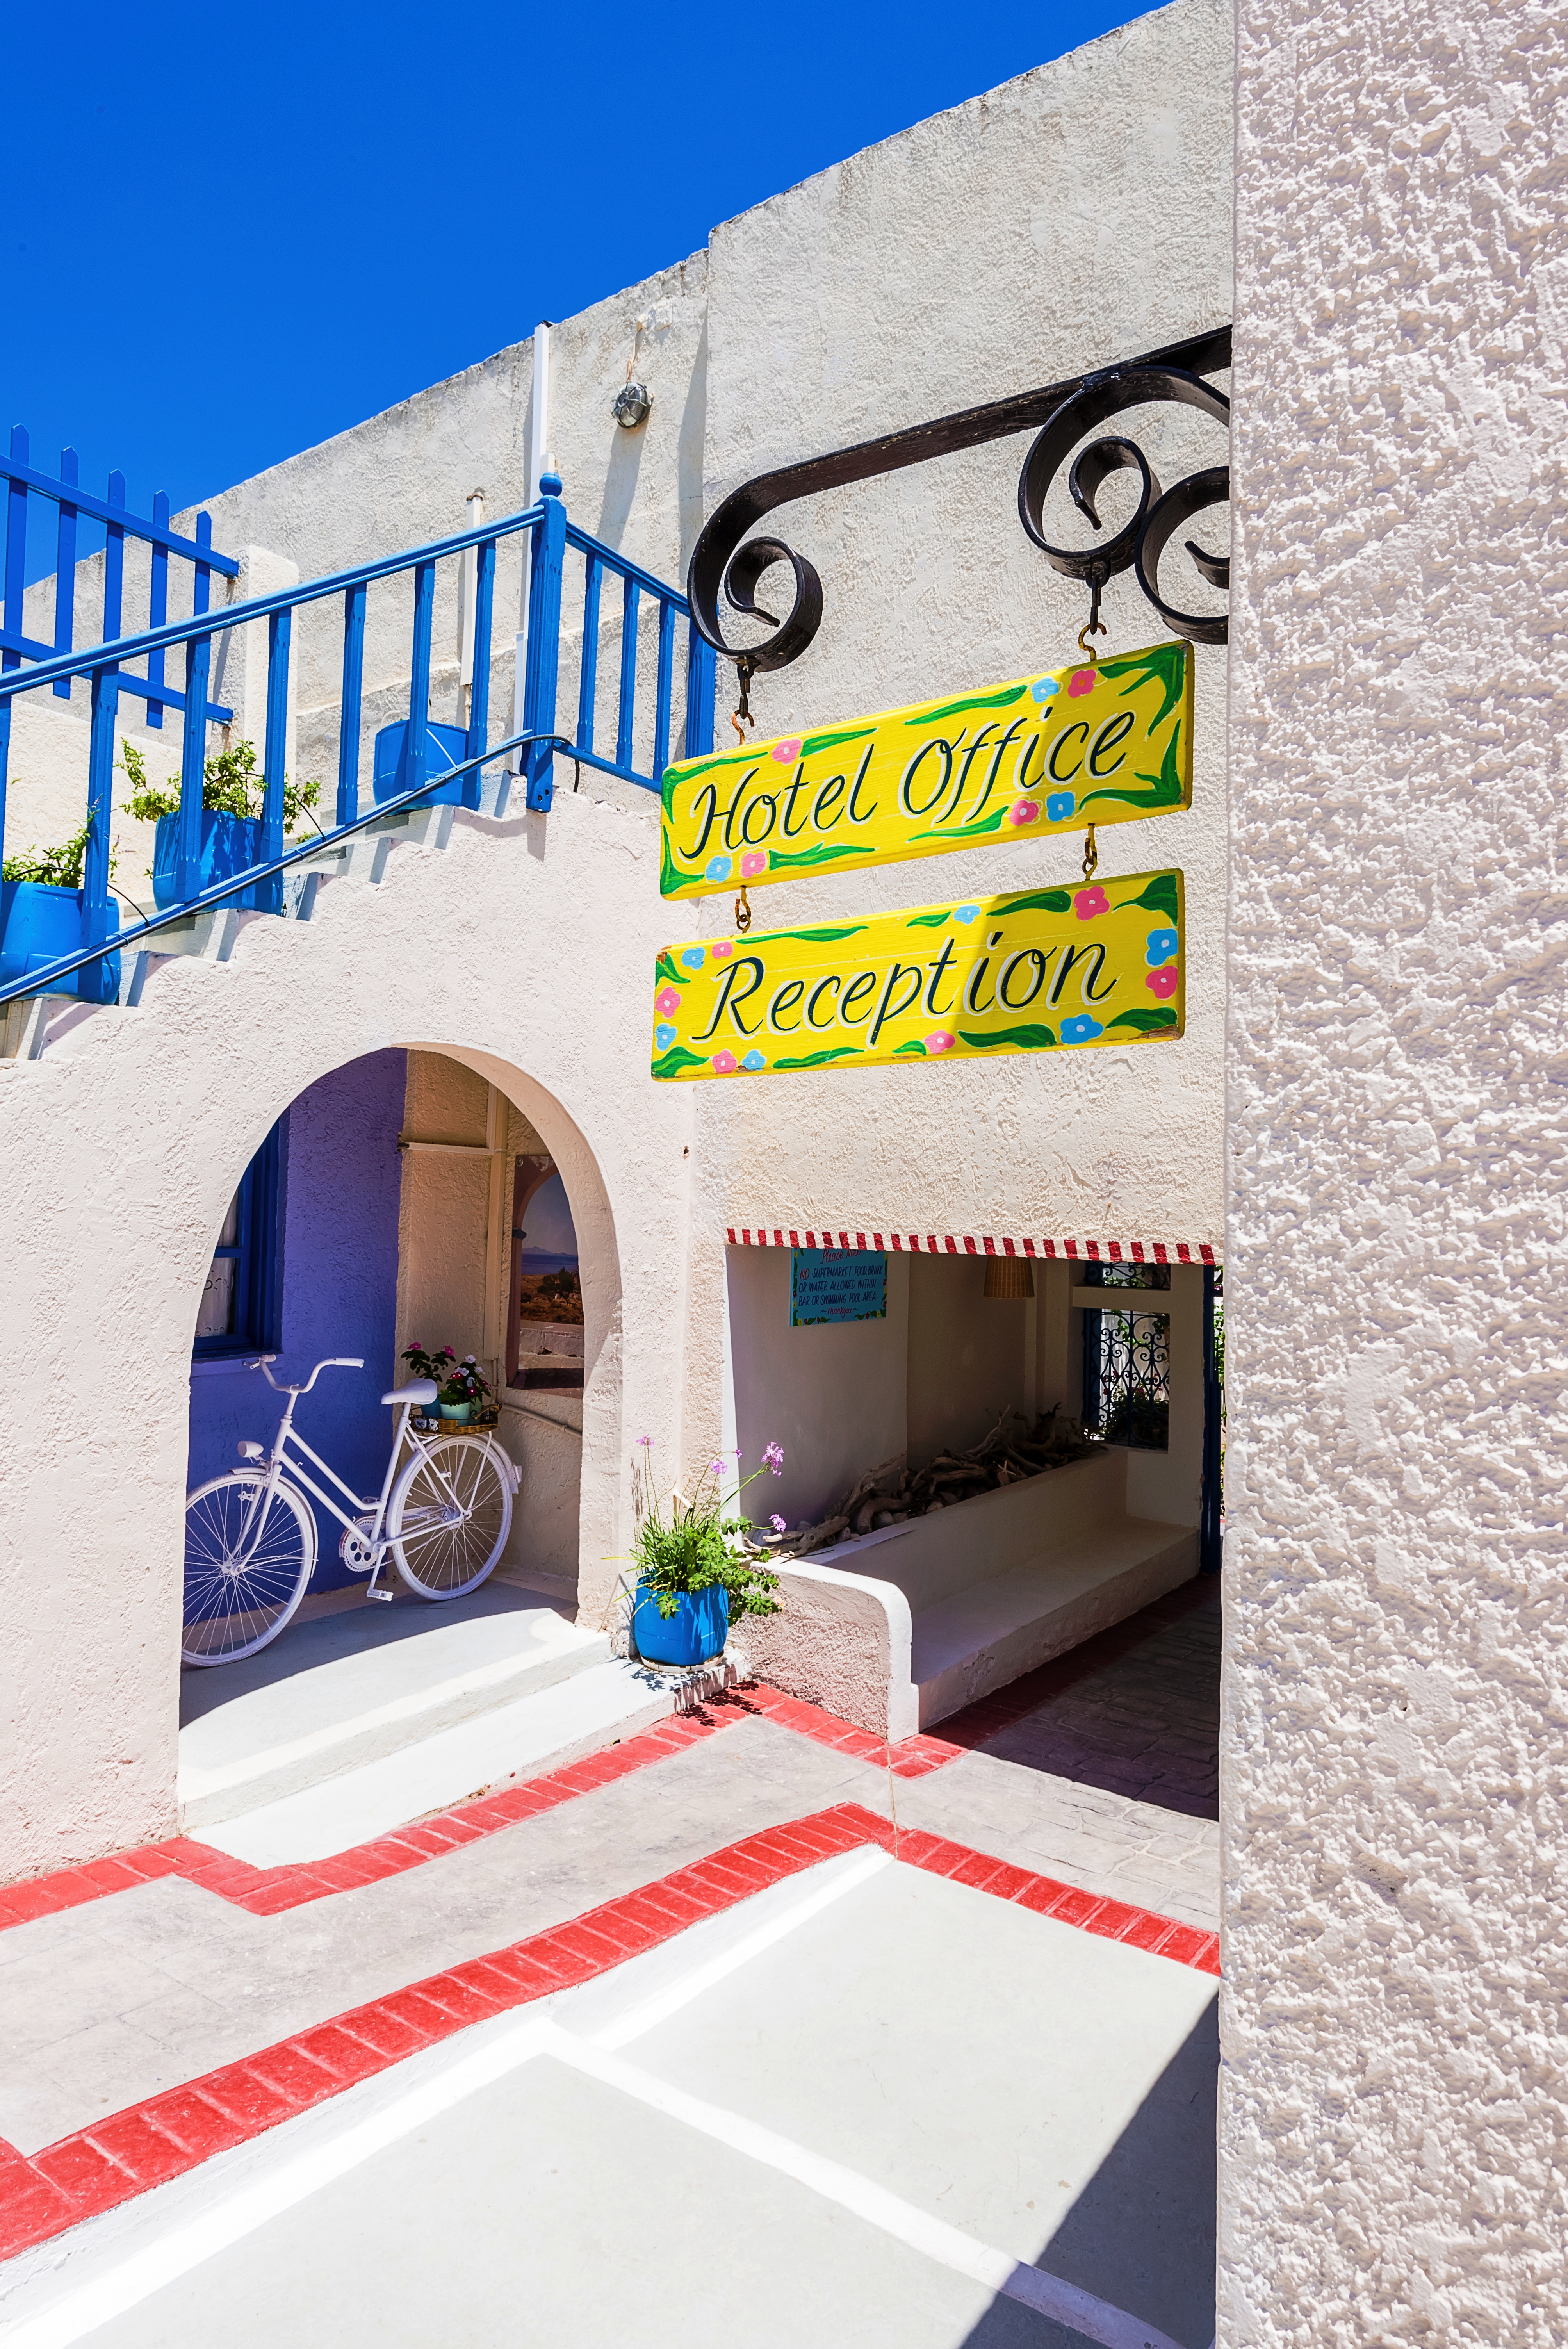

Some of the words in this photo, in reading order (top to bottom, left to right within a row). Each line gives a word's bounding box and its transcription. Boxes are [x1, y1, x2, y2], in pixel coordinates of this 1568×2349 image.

[679, 743, 878, 859] Hotel
[900, 706, 1136, 824] Office
[691, 931, 1123, 1046] Reception
[820, 1248, 843, 1265] Please
[799, 1268, 810, 1280] NO
[812, 1266, 853, 1278] SUPERMARKET
[798, 1282, 807, 1293] OR
[809, 1281, 828, 1292] WATER
[830, 1279, 856, 1291] ALLOWED
[857, 1278, 877, 1289] WITHIN
[798, 1295, 810, 1307] BAR
[811, 1295, 820, 1306] OR
[820, 1293, 847, 1305] SWIMMING
[849, 1292, 862, 1303] POOL
[862, 1291, 877, 1302] AREA
